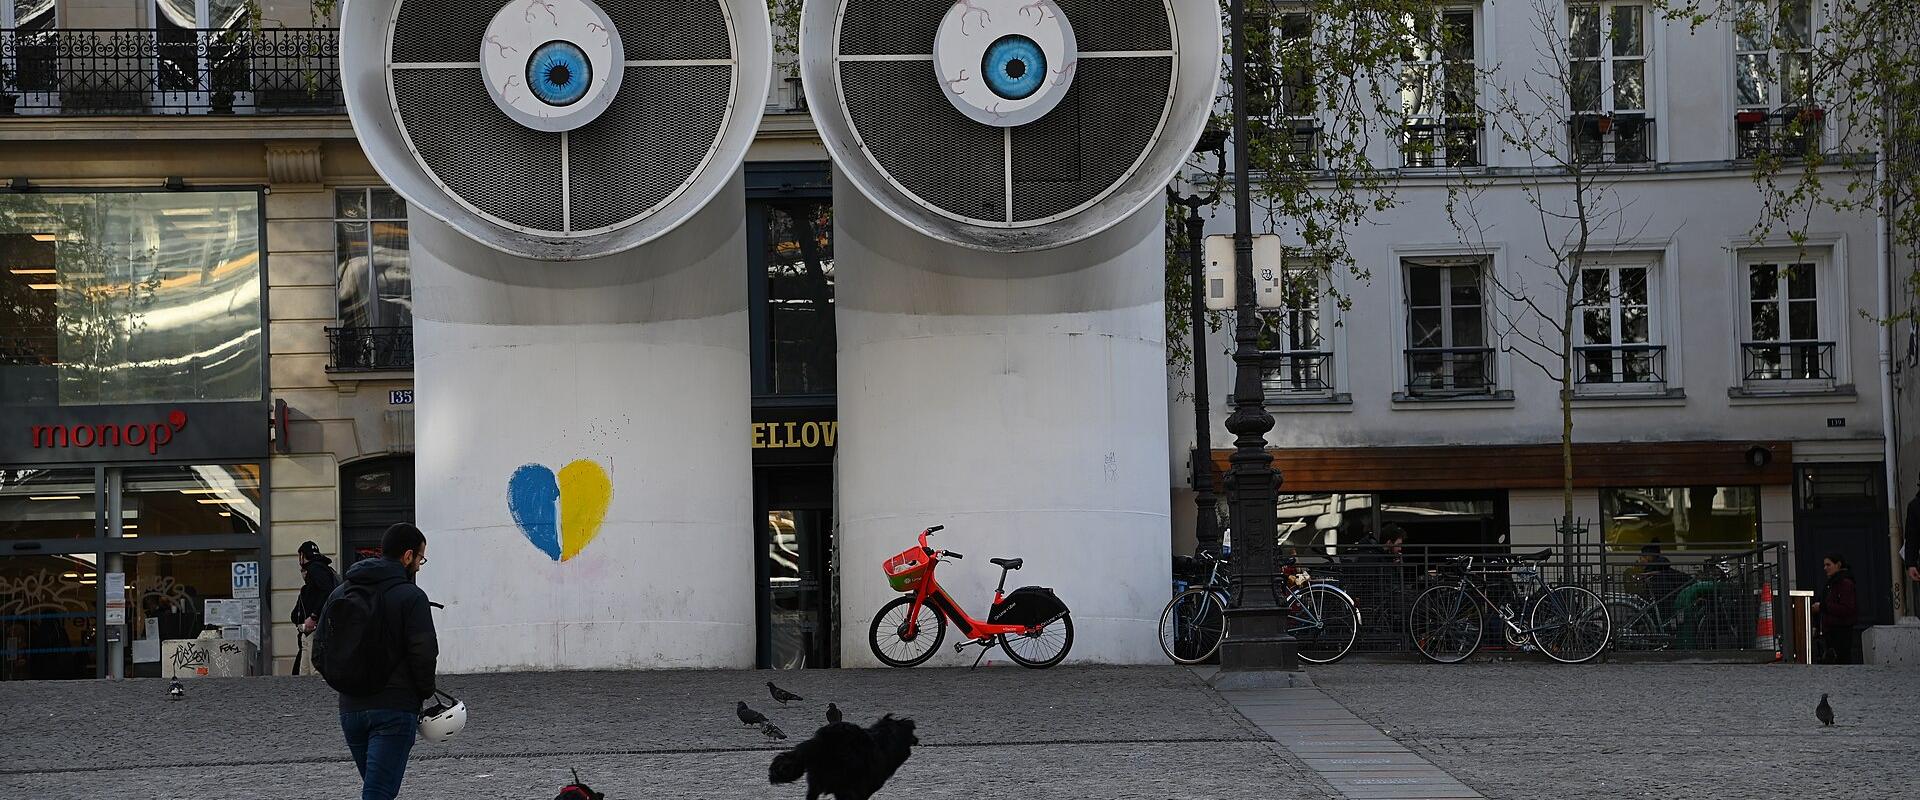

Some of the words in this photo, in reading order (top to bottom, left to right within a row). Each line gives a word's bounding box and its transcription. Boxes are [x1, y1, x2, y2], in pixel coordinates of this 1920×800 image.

[390, 390, 412, 404] 135
[233, 563, 257, 575] CH
[233, 575, 258, 587] UT!
